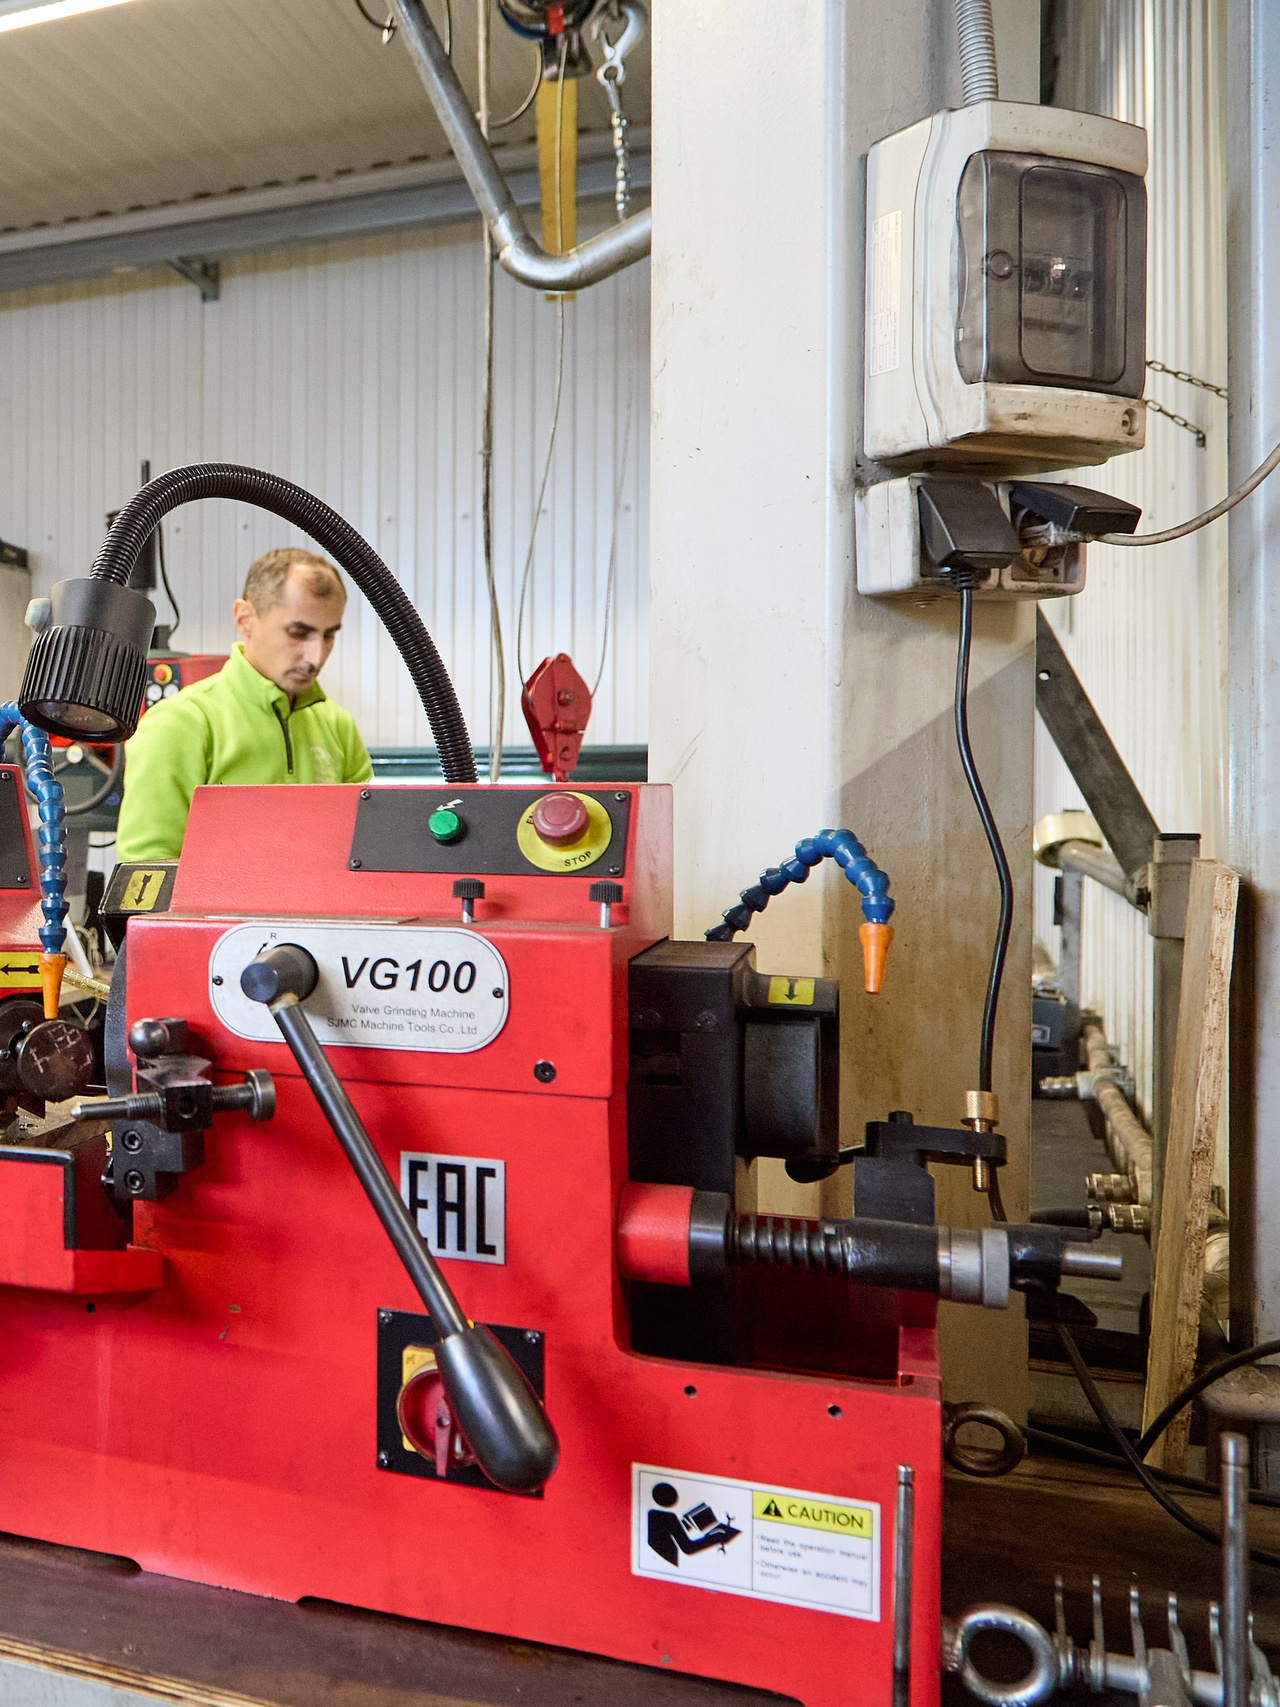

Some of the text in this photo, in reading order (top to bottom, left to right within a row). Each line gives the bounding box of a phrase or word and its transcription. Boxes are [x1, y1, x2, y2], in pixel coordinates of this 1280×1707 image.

[564, 851, 591, 867] STOP
[341, 956, 477, 993] VG100
[352, 1004, 475, 1019] Valve Grinding Machine
[327, 1017, 358, 1029] SJMC
[361, 1019, 404, 1031] Machine
[408, 1021, 436, 1033] Tools
[408, 1160, 496, 1256] EAC
[788, 1504, 864, 1529] CAUTION
[760, 1535, 780, 1544] Read
[800, 1543, 836, 1554] operation
[840, 1550, 868, 1560] manual
[760, 1545, 784, 1555] before
[760, 1560, 798, 1573] Otherwise
[815, 1571, 848, 1583] accident
[852, 1578, 868, 1587] may
